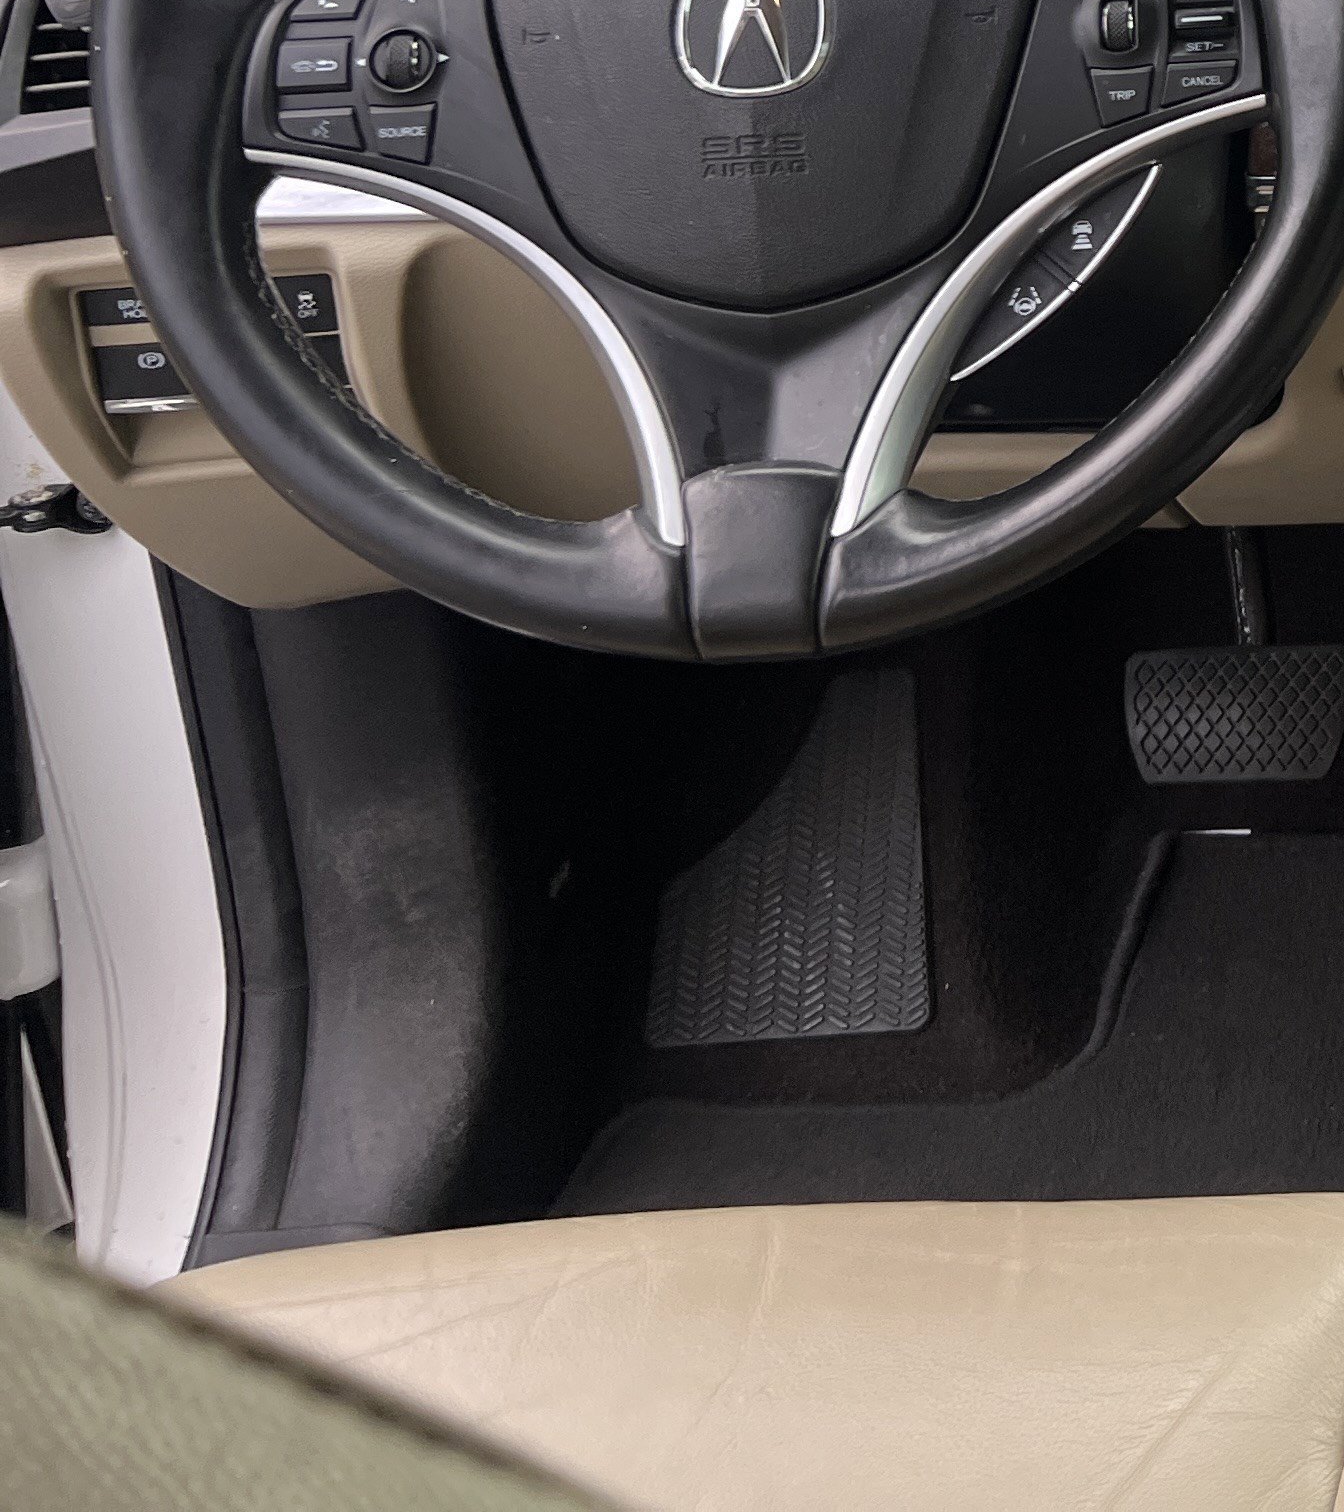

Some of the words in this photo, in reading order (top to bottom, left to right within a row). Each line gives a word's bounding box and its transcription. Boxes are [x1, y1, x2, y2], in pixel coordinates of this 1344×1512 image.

[1181, 76, 1224, 88] CANCEL
[1108, 90, 1137, 101] TRIP
[377, 125, 427, 139] SOURCE
[703, 158, 808, 179] AIRBAG
